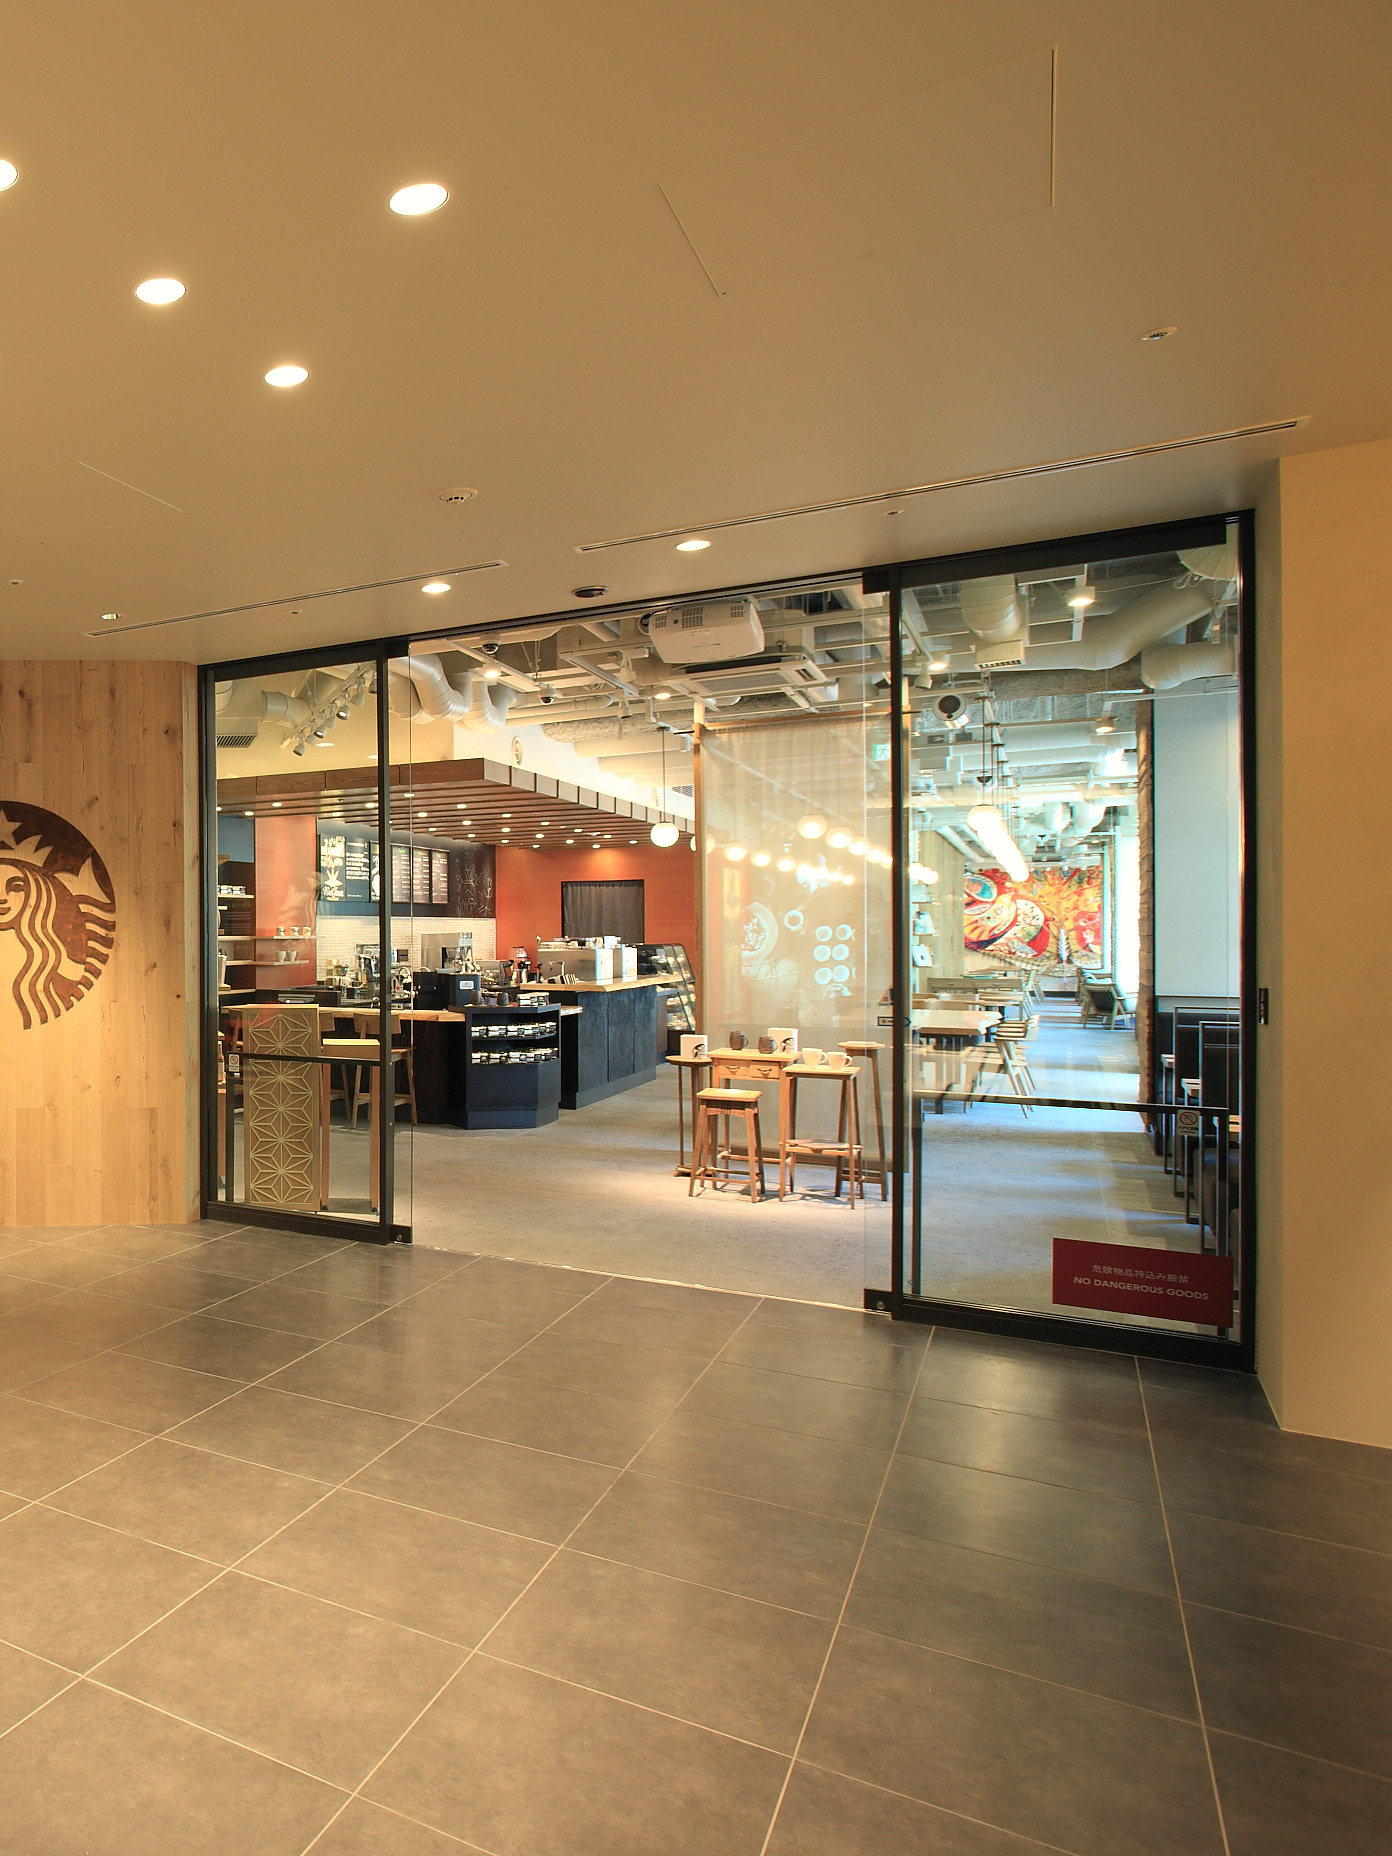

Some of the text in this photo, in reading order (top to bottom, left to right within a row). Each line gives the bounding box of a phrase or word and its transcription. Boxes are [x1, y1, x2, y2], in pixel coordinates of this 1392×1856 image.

[1073, 1276, 1209, 1300] NO DANGEROUS GOODS
